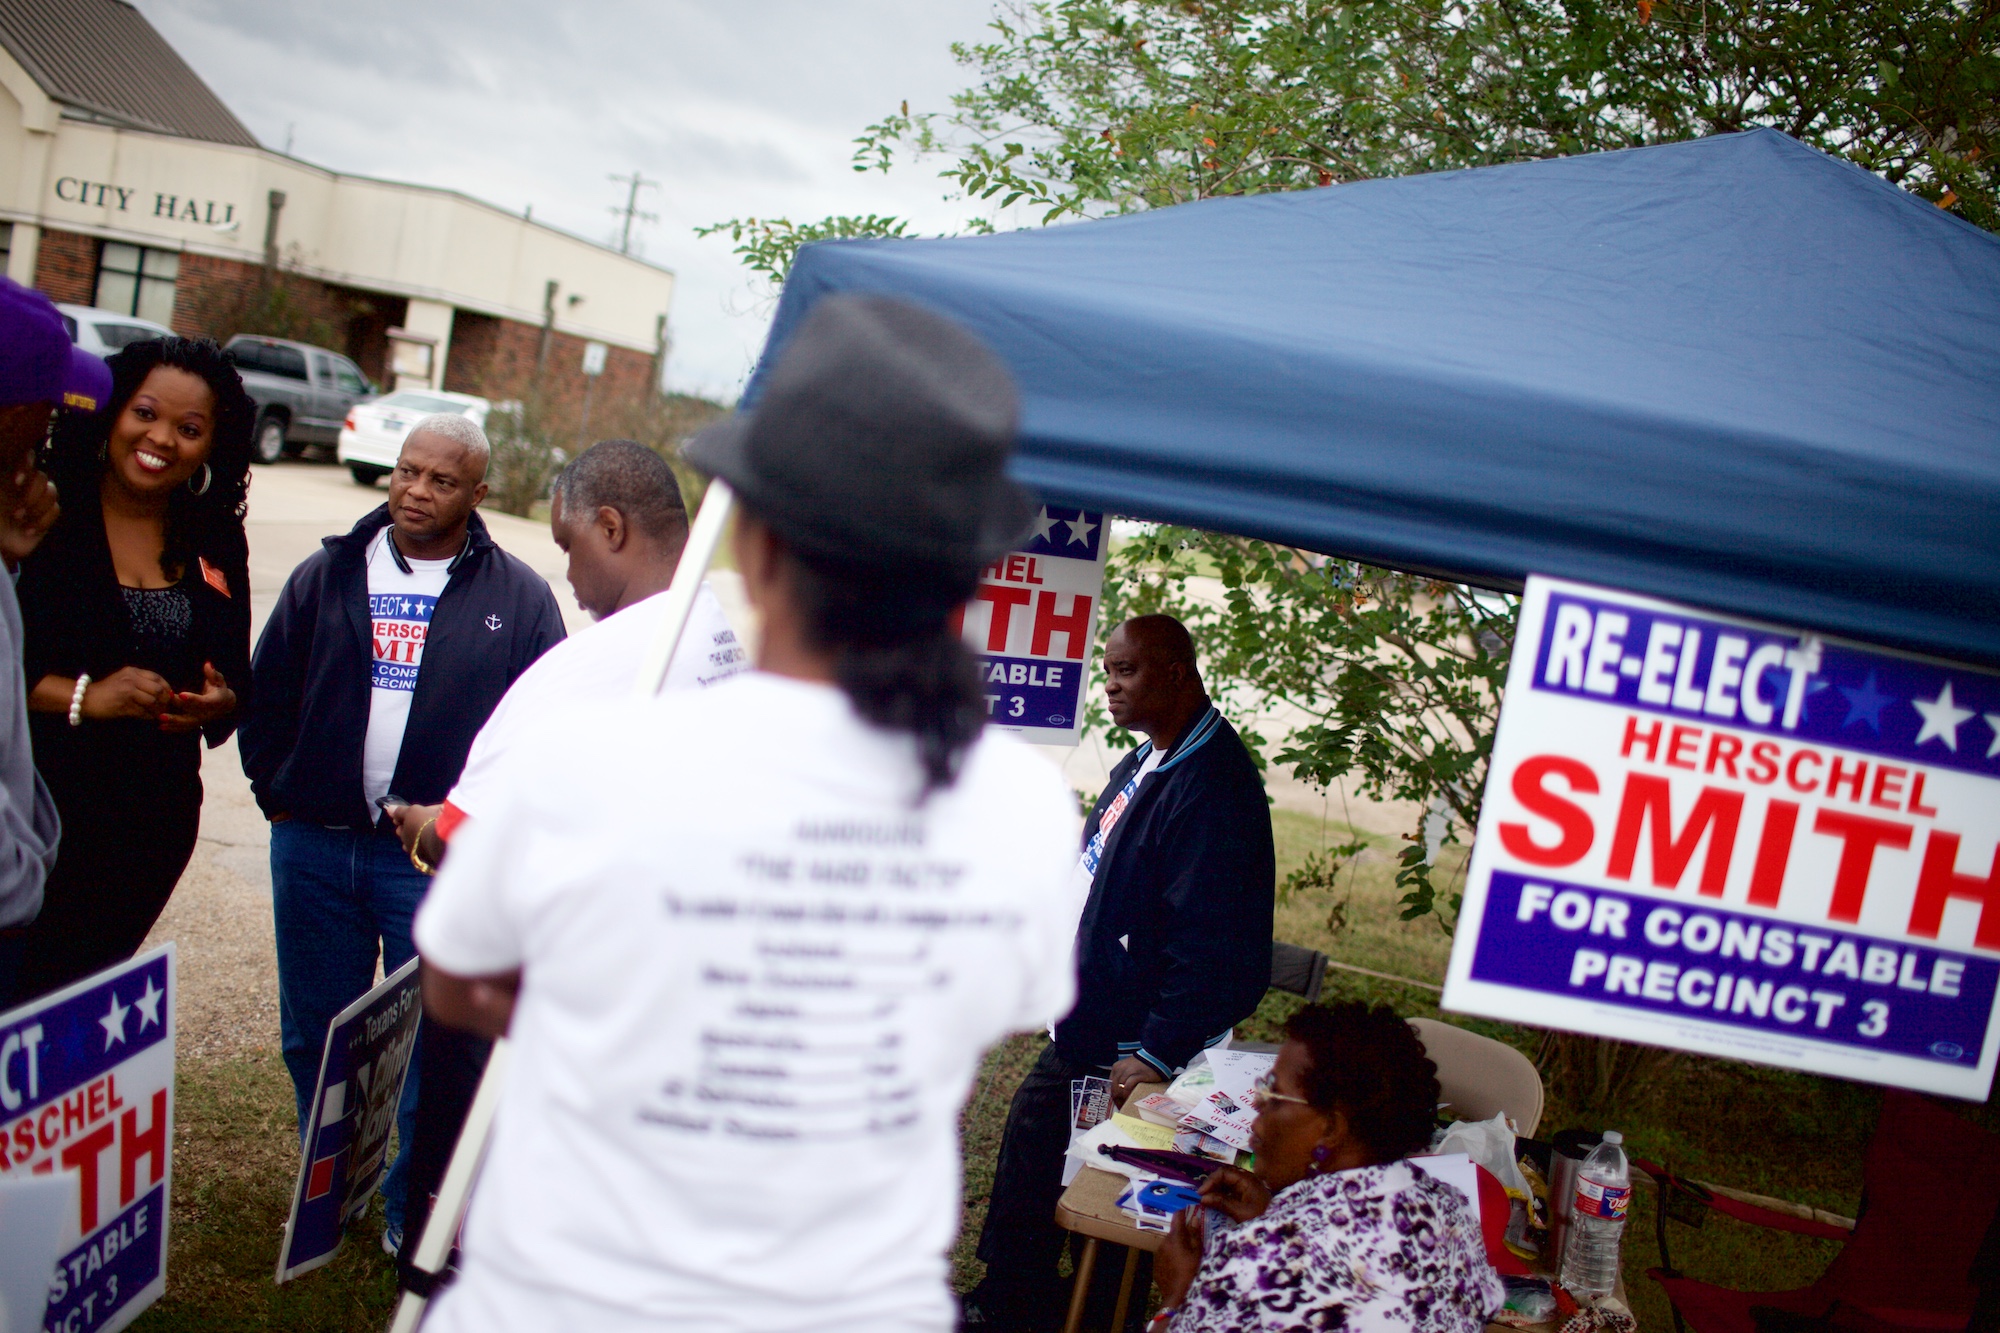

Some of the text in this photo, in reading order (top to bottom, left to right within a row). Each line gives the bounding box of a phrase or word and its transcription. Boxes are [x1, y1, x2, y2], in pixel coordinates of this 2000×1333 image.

[55, 176, 239, 227] CITY HALL
[369, 596, 402, 616] ELECT
[977, 661, 1064, 688] TABLE
[1544, 602, 1820, 731] RE-ELECT
[1008, 695, 1026, 718] 3
[1620, 714, 1938, 819] HERSCHEL
[1498, 753, 2000, 953] SMITH
[1516, 883, 1965, 998] FOR CONSTABLE
[365, 986, 414, 1045] Texans For
[1569, 948, 1845, 1031] PRECINCT
[1856, 999, 1890, 1039] 3
[0, 1072, 124, 1174] RSCHEL
[1085, 1095, 1101, 1123] CEDRIC
[49, 1203, 149, 1306] STABLE
[104, 1273, 119, 1308] 3
